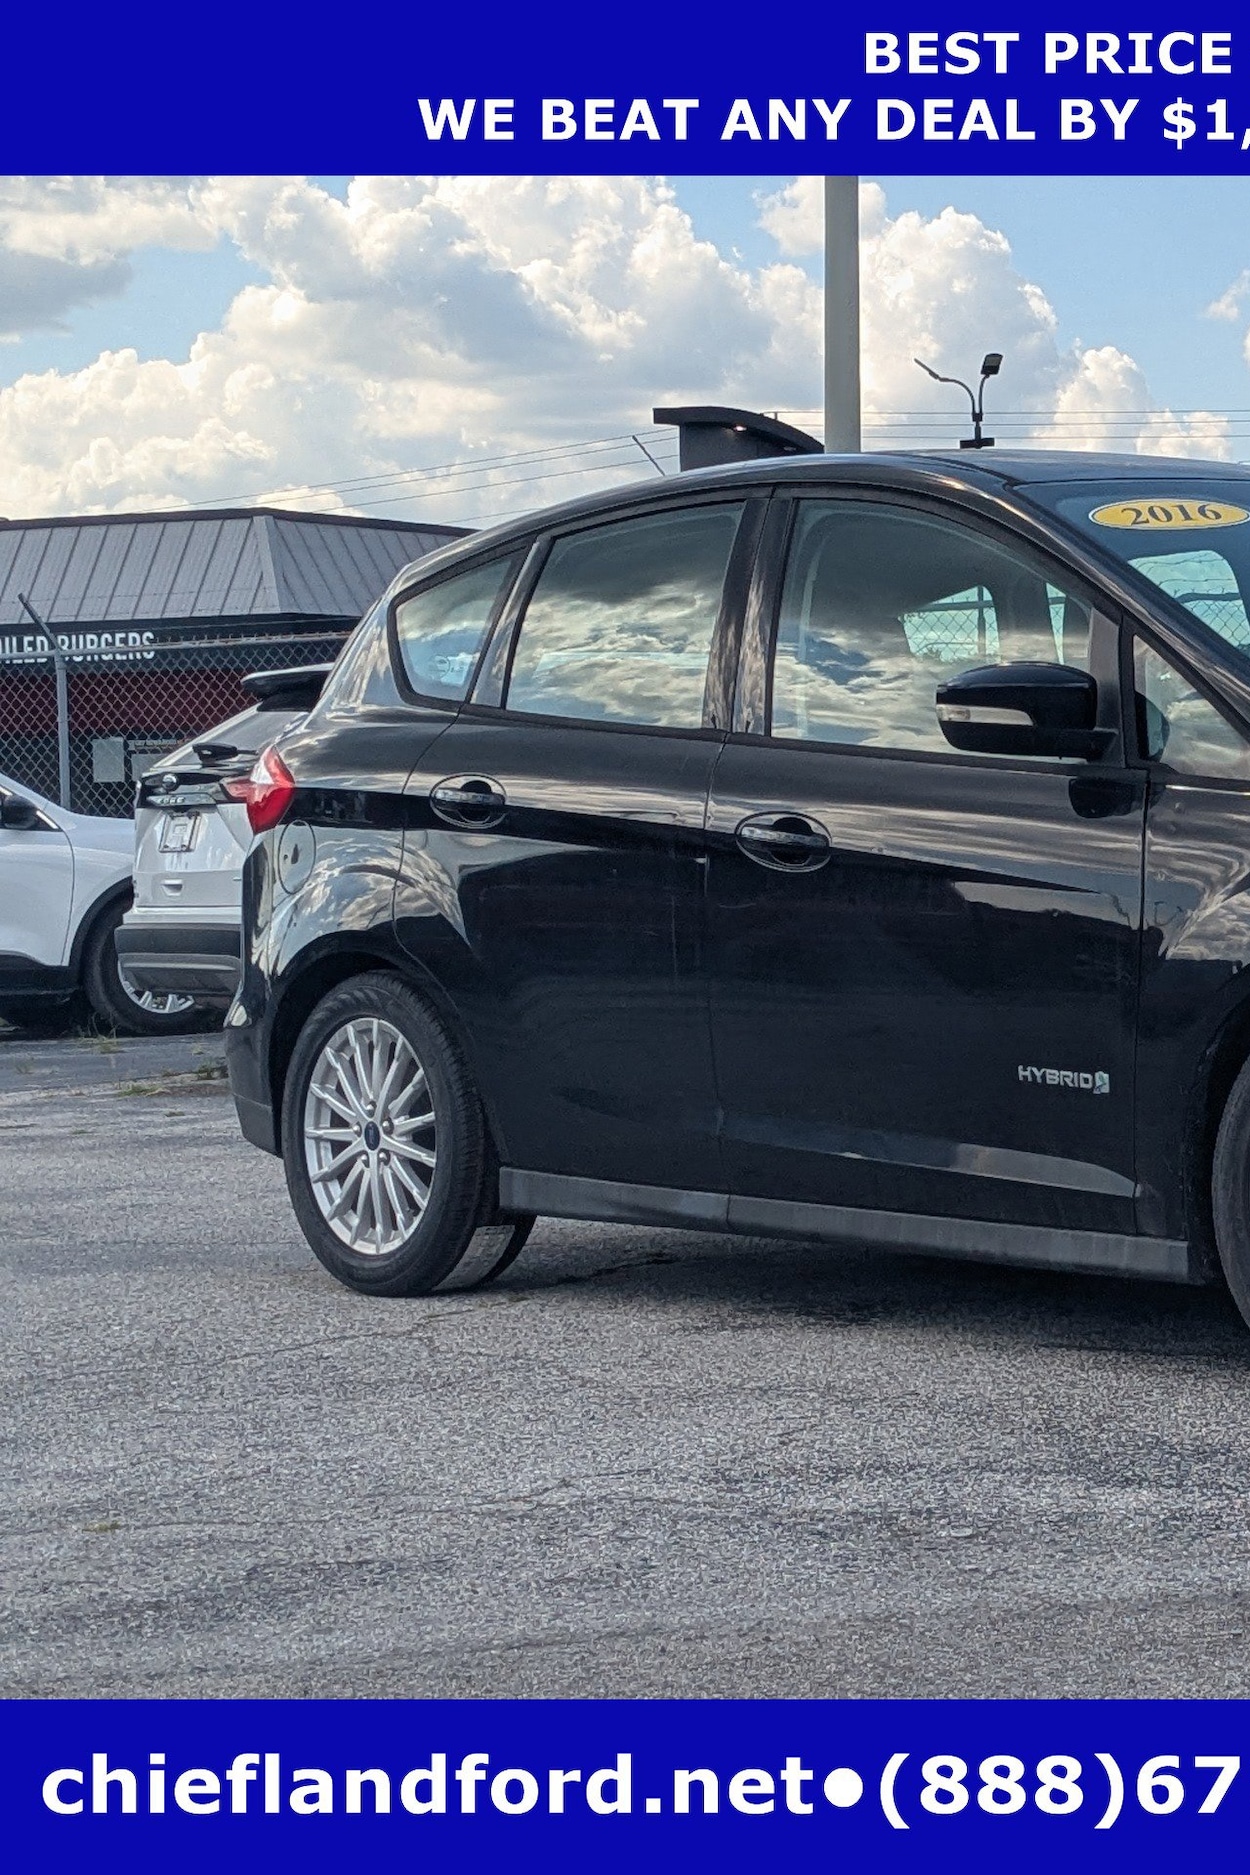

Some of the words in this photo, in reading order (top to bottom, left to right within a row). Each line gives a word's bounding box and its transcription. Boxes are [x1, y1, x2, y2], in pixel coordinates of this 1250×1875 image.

[1121, 503, 1222, 526] 2016
[0, 635, 48, 664] ILED
[57, 631, 155, 662] BURGERS
[1018, 1064, 1093, 1090] HYBRID
